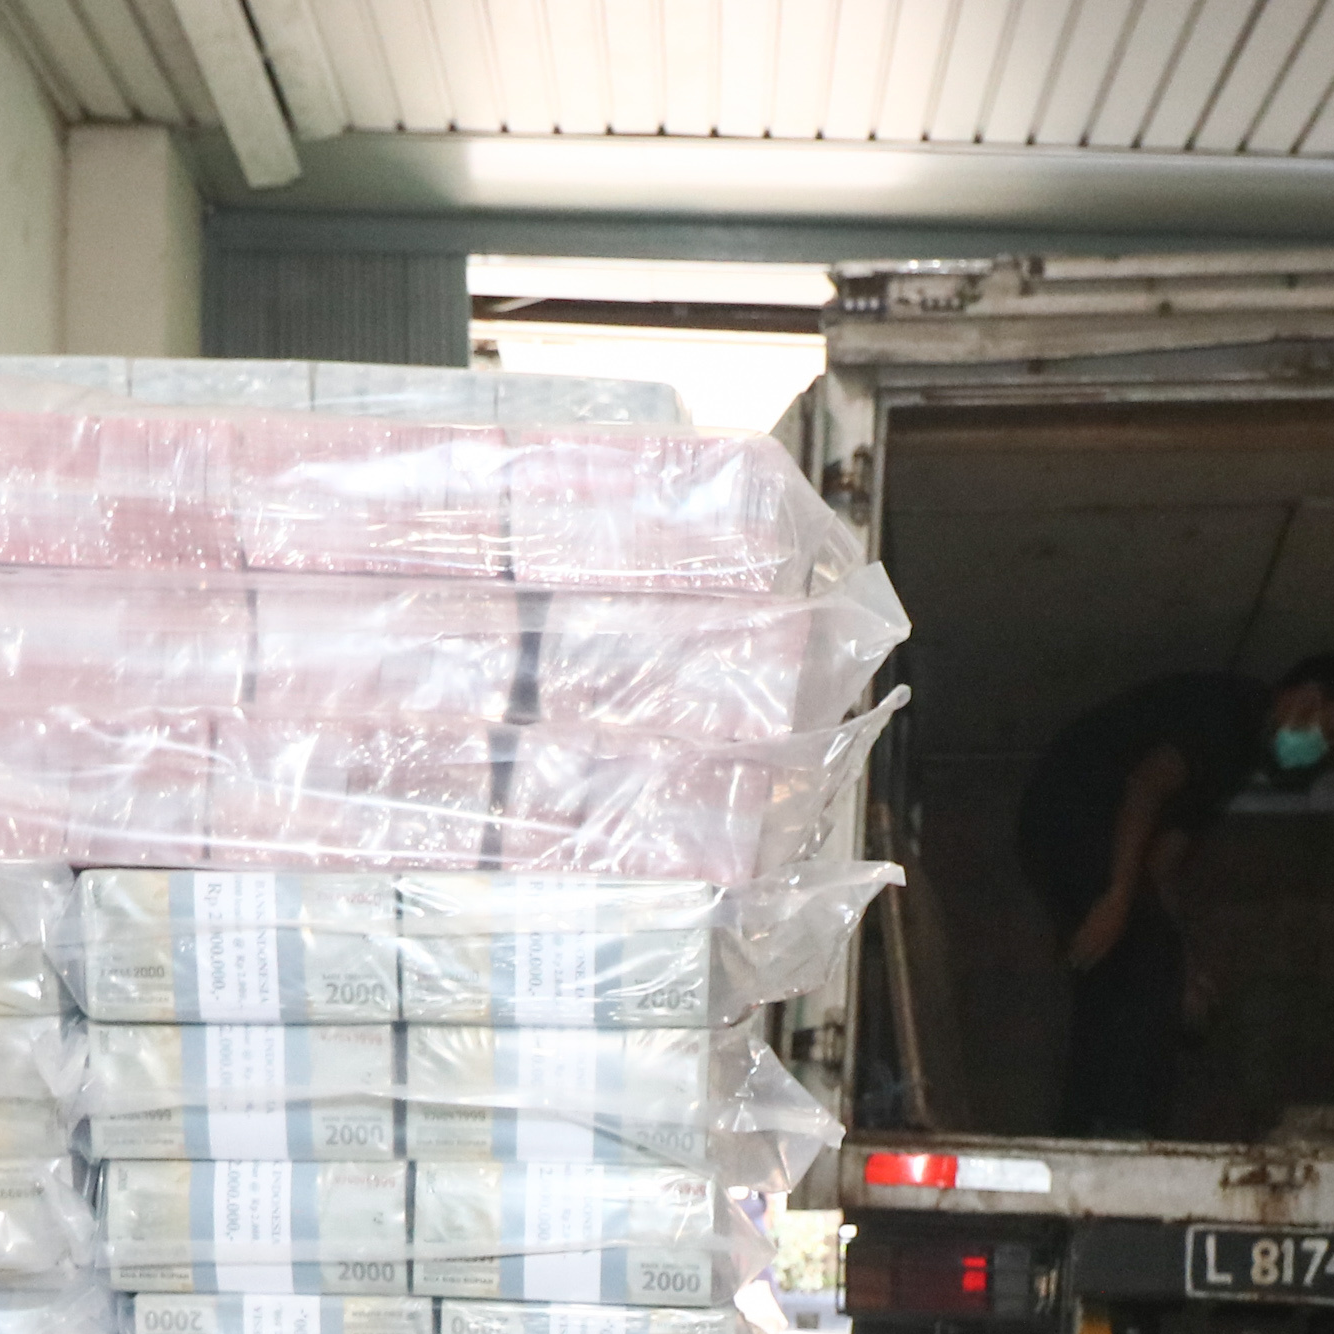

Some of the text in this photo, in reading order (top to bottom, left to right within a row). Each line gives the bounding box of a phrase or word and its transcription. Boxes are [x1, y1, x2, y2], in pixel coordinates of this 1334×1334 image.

[205, 883, 223, 907] Rp
[254, 879, 267, 921] BANK
[325, 982, 386, 1005] 2000
[325, 1124, 384, 1145] 2000
[1205, 1233, 1233, 1285] L
[338, 1261, 395, 1282] 2000
[642, 1270, 701, 1293] 2000
[145, 1309, 203, 1331] 2000
